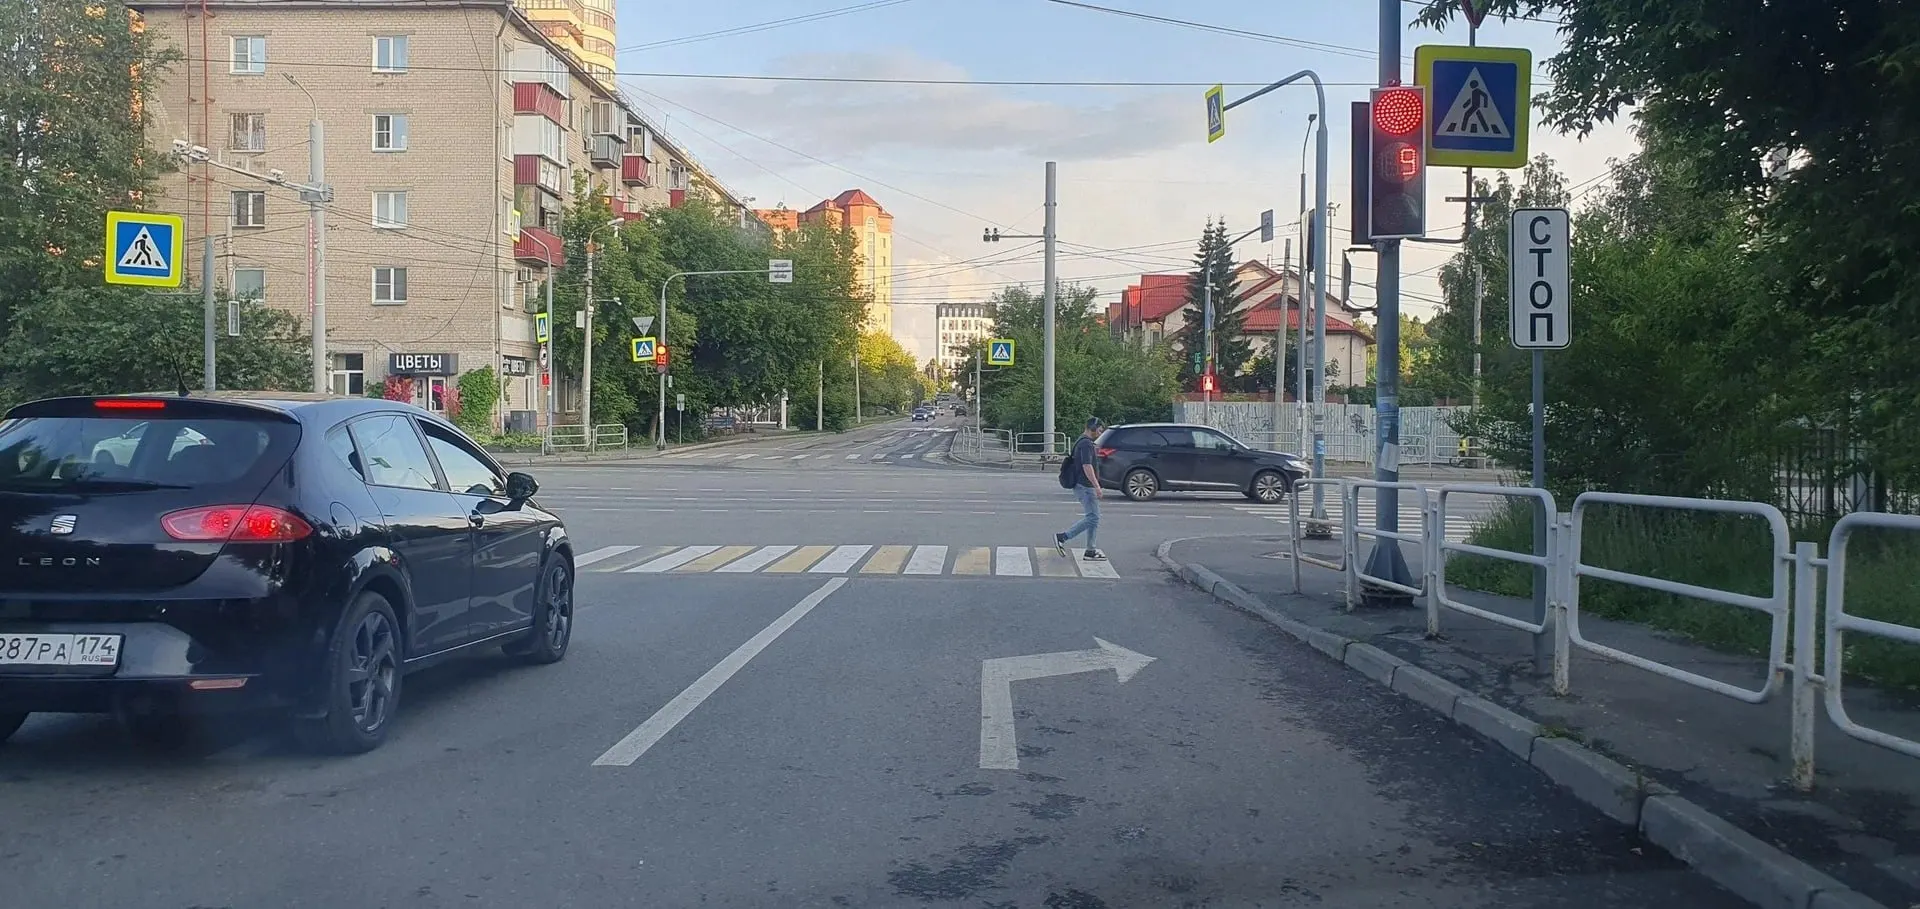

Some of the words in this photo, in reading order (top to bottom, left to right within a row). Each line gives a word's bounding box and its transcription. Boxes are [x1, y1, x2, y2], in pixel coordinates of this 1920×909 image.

[1400, 148, 1416, 175] 9
[1529, 215, 1553, 342] СТОП
[396, 354, 442, 370] ЦВЕТЫ
[18, 557, 100, 566] LEON
[76, 637, 113, 655] 174
[81, 654, 100, 662] RUS
